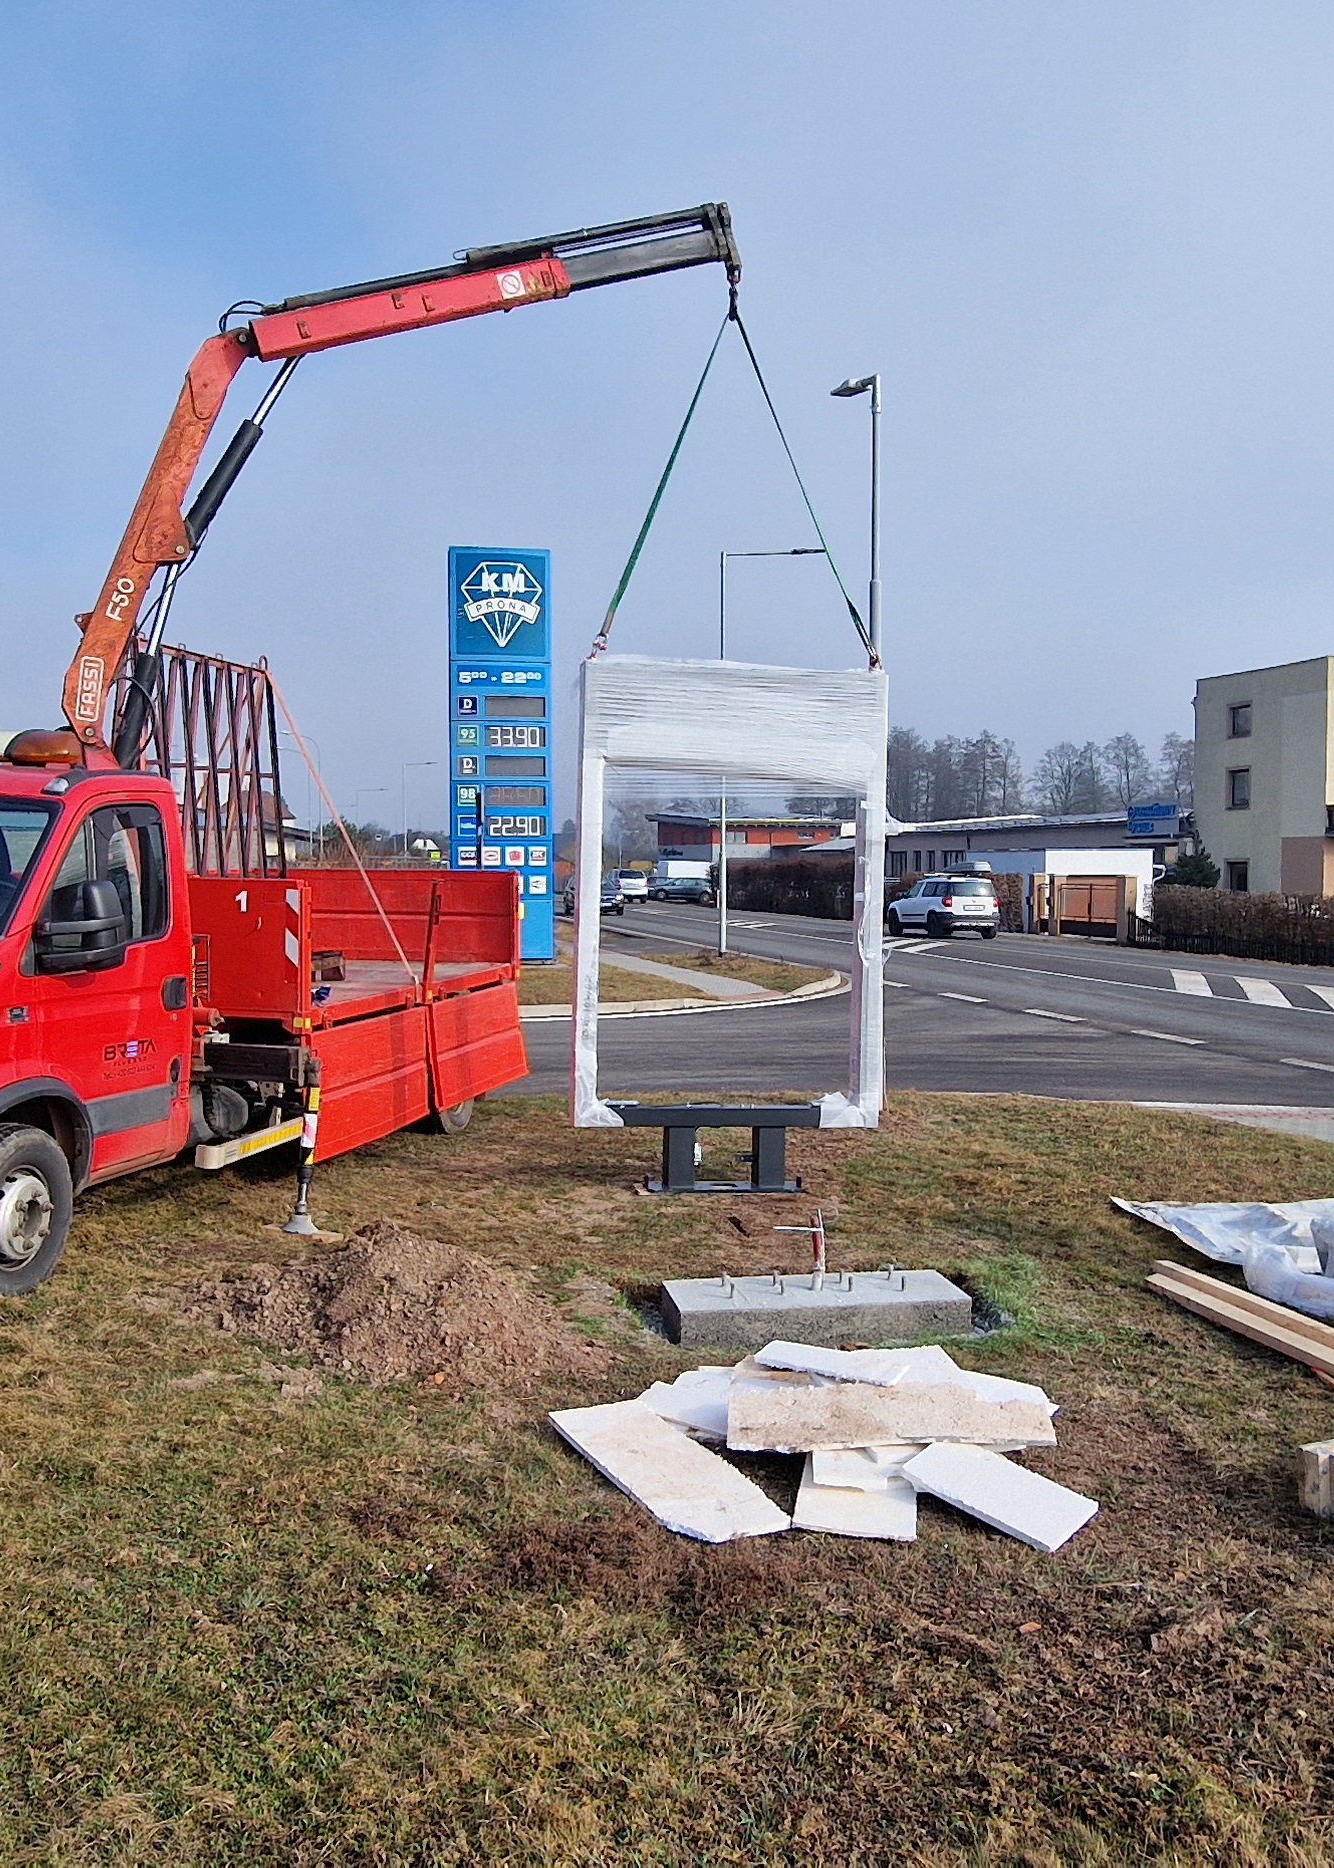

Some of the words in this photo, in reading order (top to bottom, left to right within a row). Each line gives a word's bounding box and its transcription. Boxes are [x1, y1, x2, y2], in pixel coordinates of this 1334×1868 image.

[481, 572, 526, 593] KM
[105, 577, 135, 622] F50
[476, 600, 527, 614] PRONA
[80, 658, 100, 717] FASSI
[463, 698, 473, 709] D
[460, 728, 476, 739] 95
[460, 787, 476, 799] 98
[235, 890, 248, 913] 1
[104, 1039, 156, 1061] BRETA
